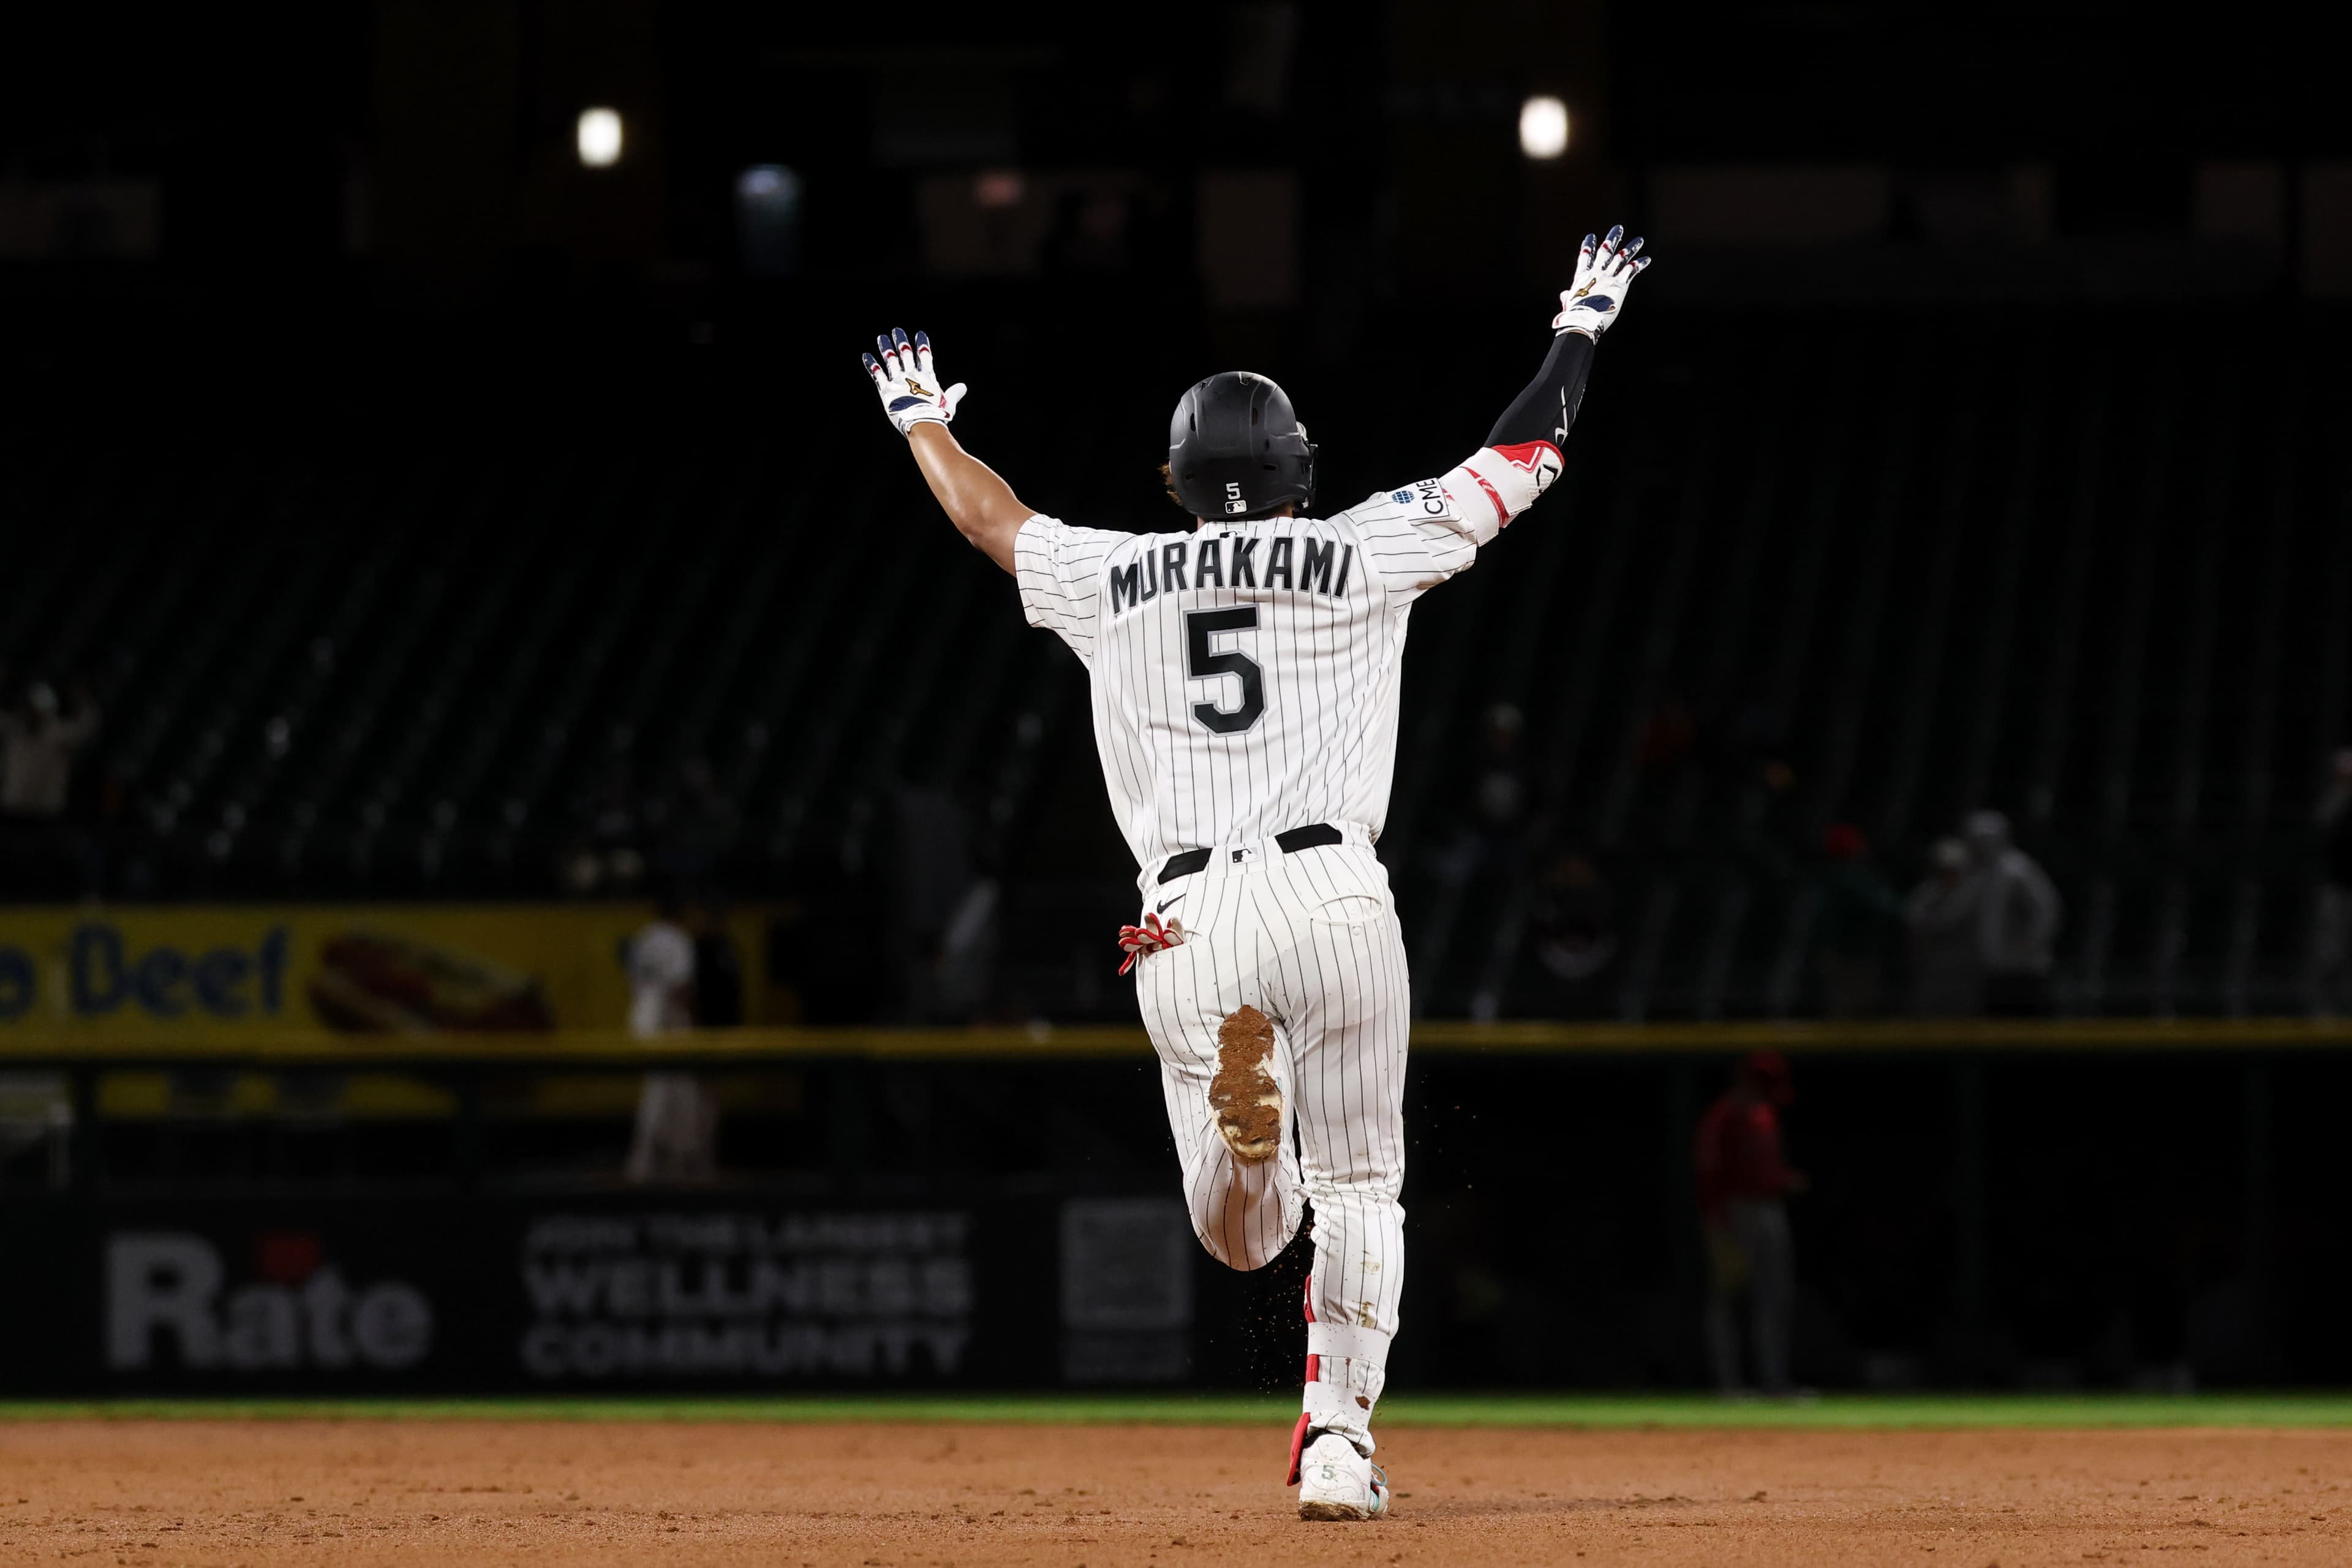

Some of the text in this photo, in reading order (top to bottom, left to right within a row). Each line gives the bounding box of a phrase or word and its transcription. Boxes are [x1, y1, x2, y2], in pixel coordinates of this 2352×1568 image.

[1226, 482, 1240, 499] 5
[1416, 480, 1443, 514] CME
[1110, 535, 1353, 616] MURAKAMI
[1183, 603, 1268, 737] 5
[69, 922, 290, 1019] Beef
[104, 1231, 435, 1368] Rate
[524, 1259, 971, 1315] WELLNESS
[523, 1325, 967, 1373] COMMUNITY
[1321, 1464, 1335, 1480] 5
